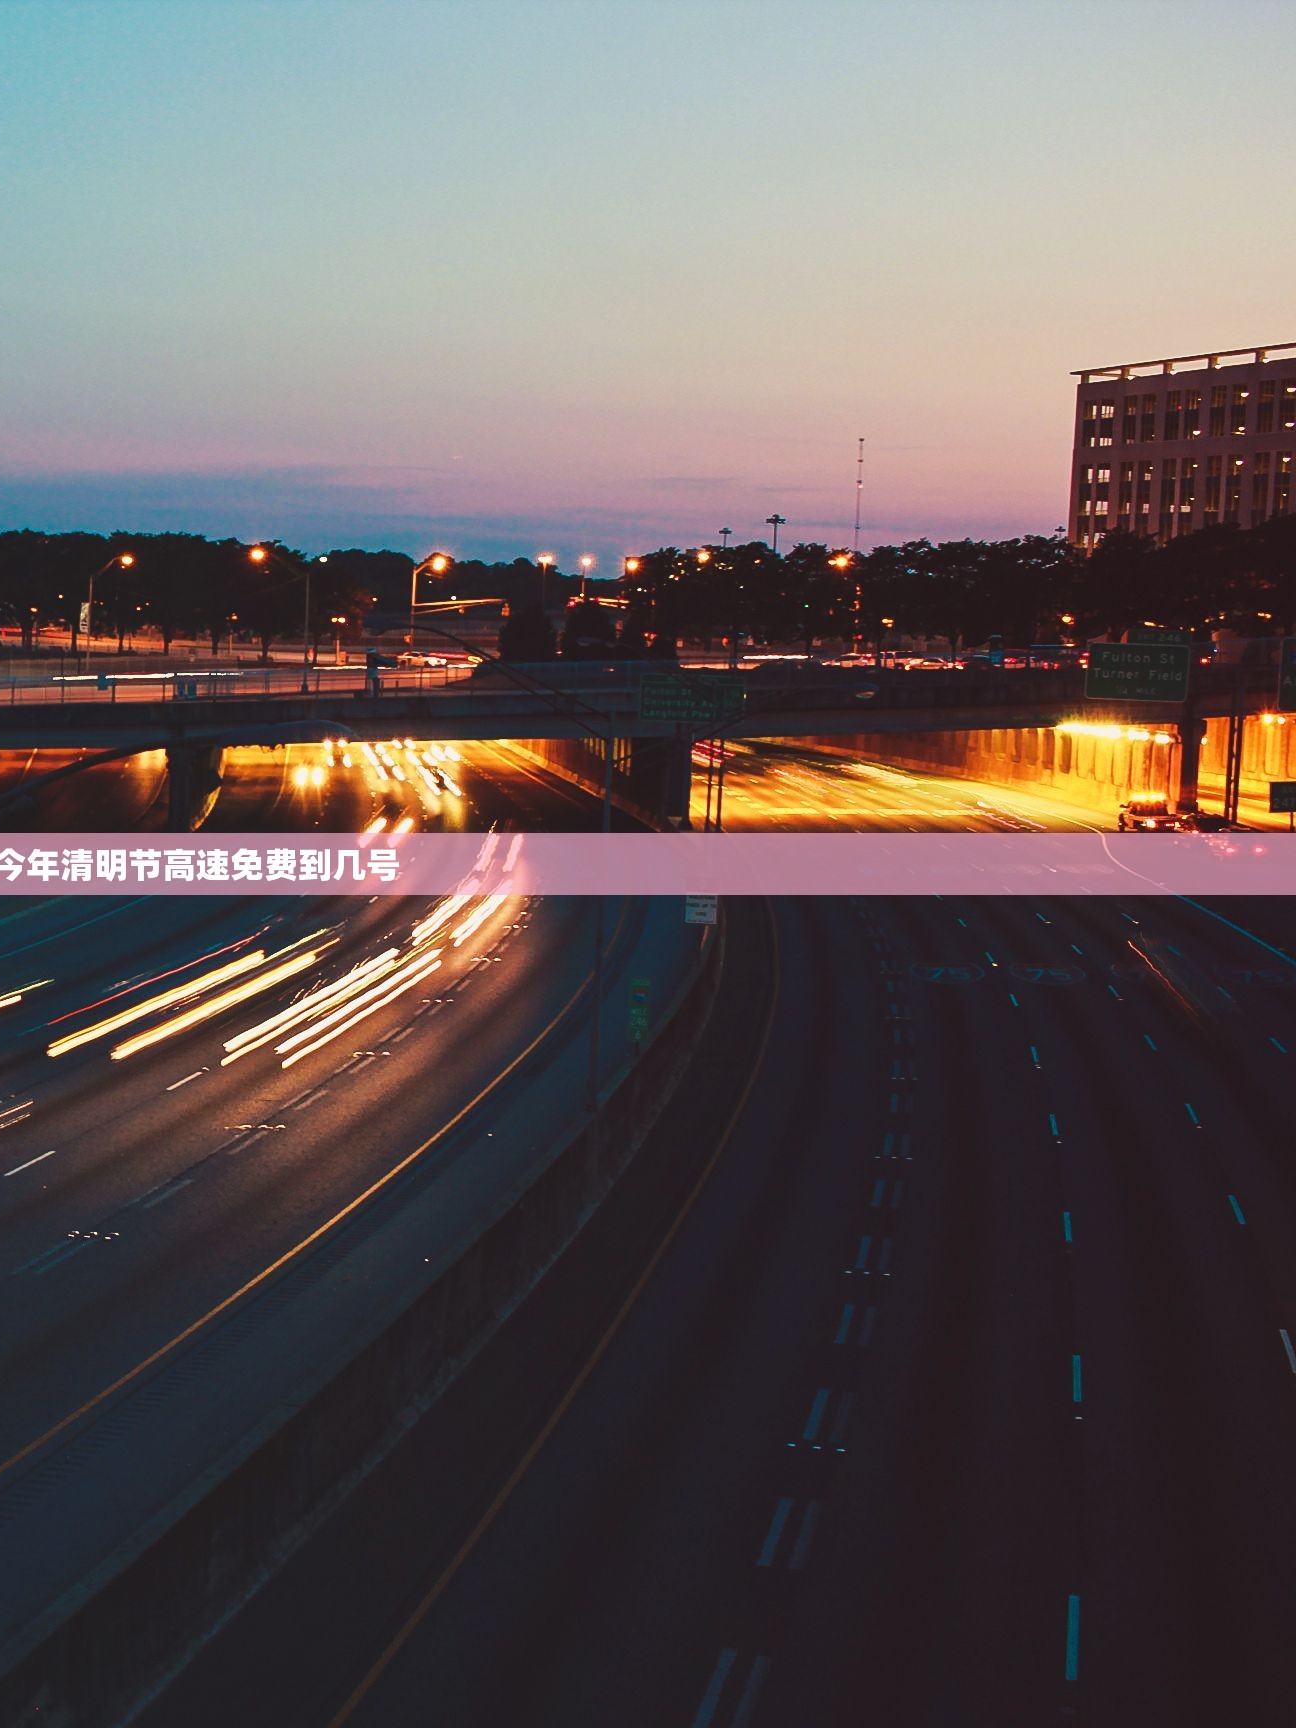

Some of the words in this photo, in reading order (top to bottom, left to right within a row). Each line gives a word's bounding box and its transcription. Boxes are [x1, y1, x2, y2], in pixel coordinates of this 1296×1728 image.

[1102, 651, 1151, 664] Fulton
[1160, 653, 1175, 664] St
[1093, 667, 1139, 679] Turner
[1149, 669, 1183, 681] Field
[927, 966, 972, 981] 75
[1025, 966, 1073, 981] 75
